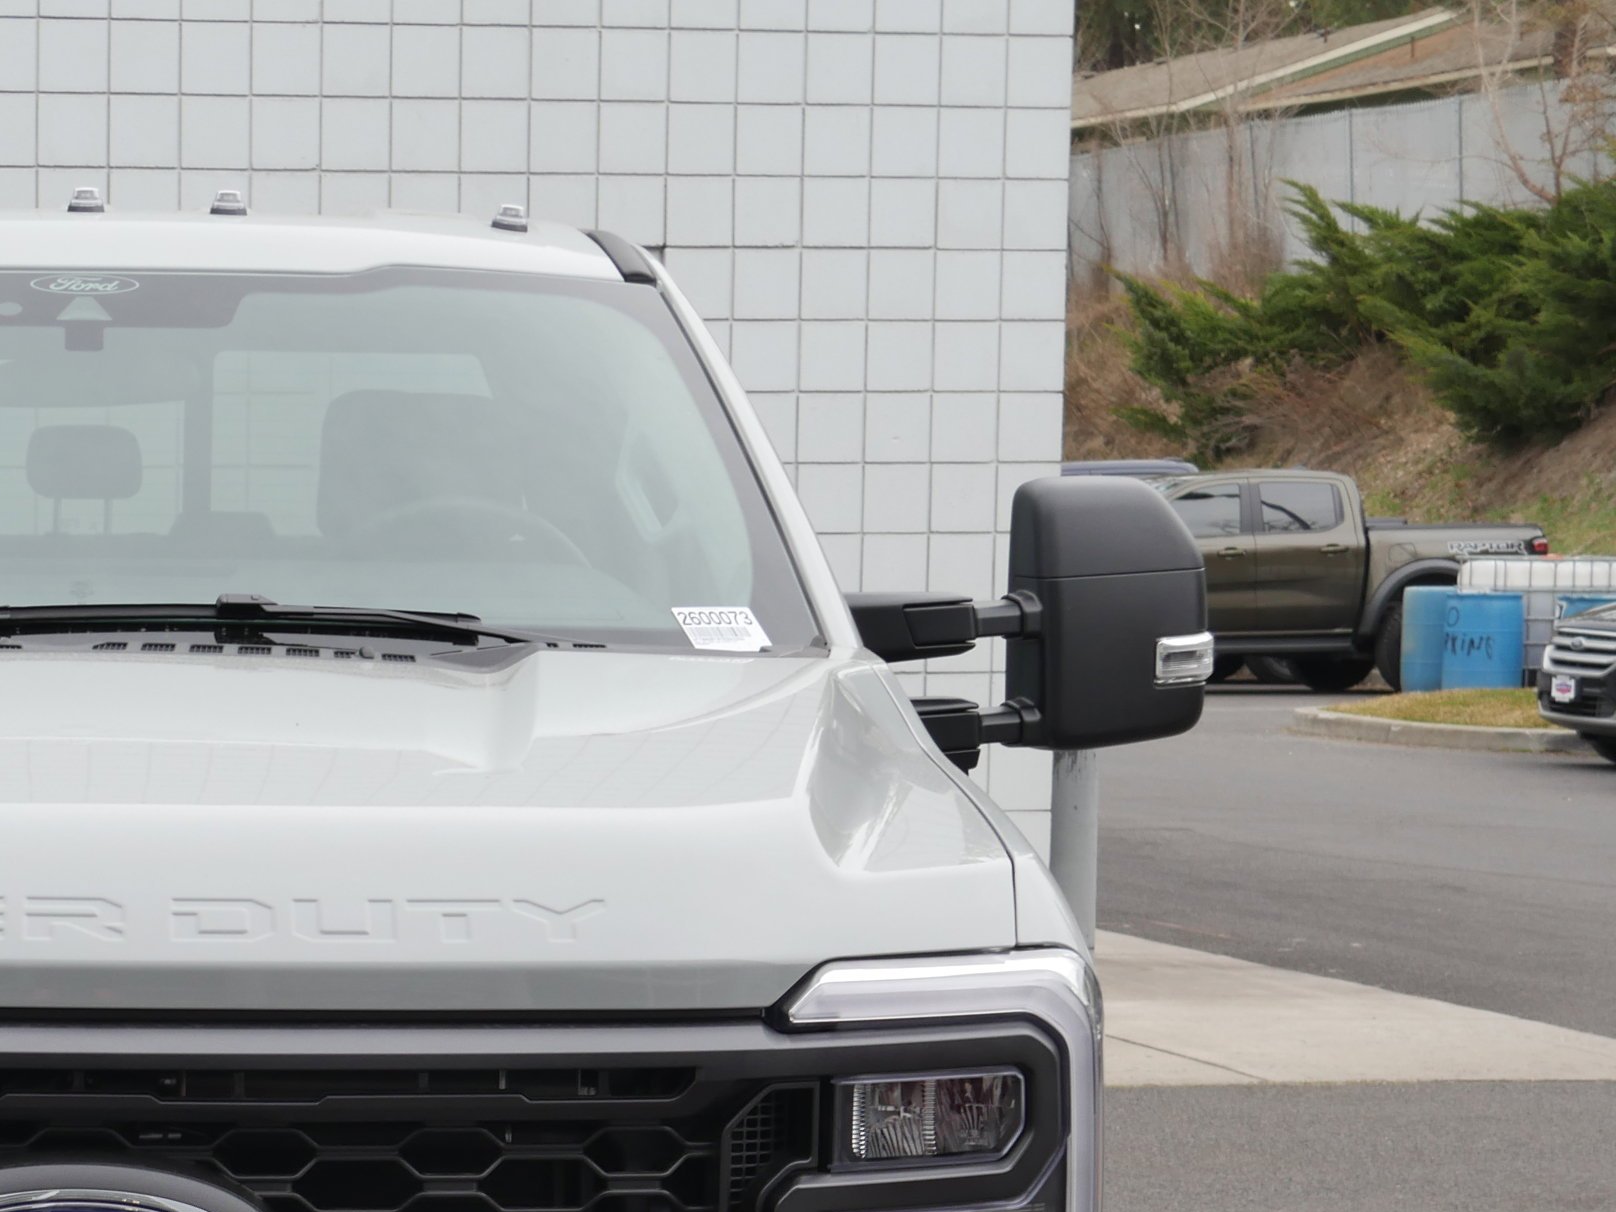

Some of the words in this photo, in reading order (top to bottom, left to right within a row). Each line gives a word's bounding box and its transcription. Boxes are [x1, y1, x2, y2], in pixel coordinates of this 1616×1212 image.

[49, 277, 120, 291] Ford
[677, 611, 753, 625] 2600073
[170, 897, 607, 943] DUTY
